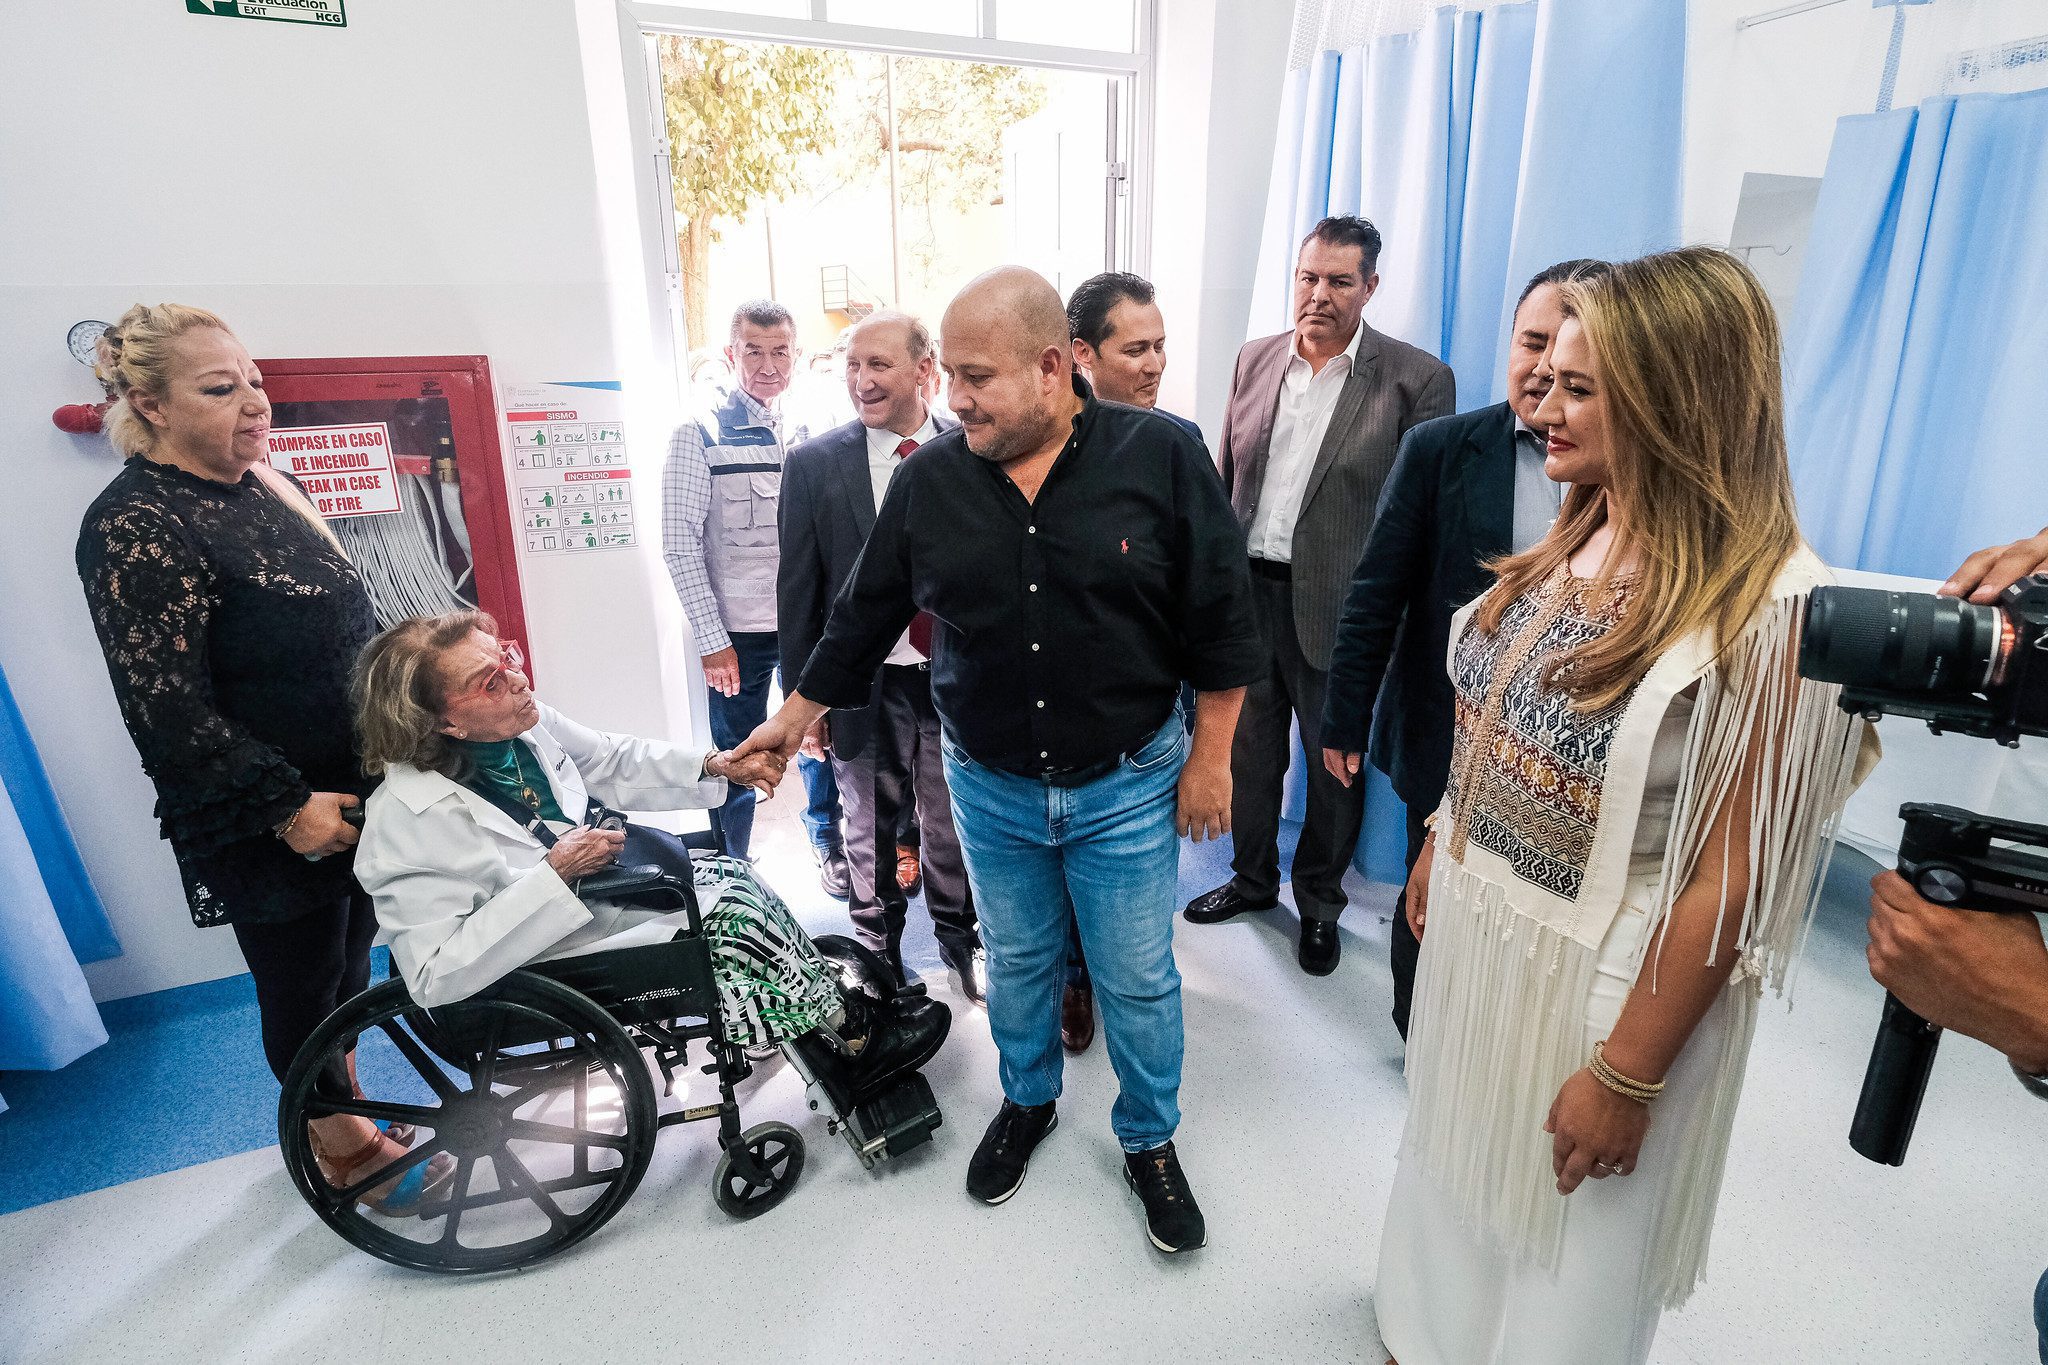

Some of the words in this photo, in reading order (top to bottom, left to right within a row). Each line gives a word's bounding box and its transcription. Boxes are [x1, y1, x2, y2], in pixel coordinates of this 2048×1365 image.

[244, 6, 267, 15] EXIT
[316, 13, 340, 22] HCG
[546, 412, 576, 420] SISMO
[516, 436, 520, 444] 1
[554, 434, 560, 442] 2
[592, 432, 598, 441] 3
[268, 435, 330, 452] RÓMPASE
[331, 434, 347, 450] EN
[349, 432, 382, 447] CASO
[291, 457, 308, 471] DE
[310, 453, 370, 470] INCENDIO
[519, 459, 525, 467] 4
[557, 457, 562, 465] 5
[594, 455, 600, 463] 6
[567, 472, 609, 480] INCENDIO
[333, 478, 348, 492] IN
[350, 475, 381, 490] CASE
[562, 495, 568, 503] 2
[598, 492, 604, 501] 3
[318, 498, 333, 512] OF
[336, 496, 362, 512] FIRE
[564, 518, 570, 526] 5
[601, 515, 607, 523] 6
[567, 539, 572, 547] 8
[603, 536, 609, 544] 9
